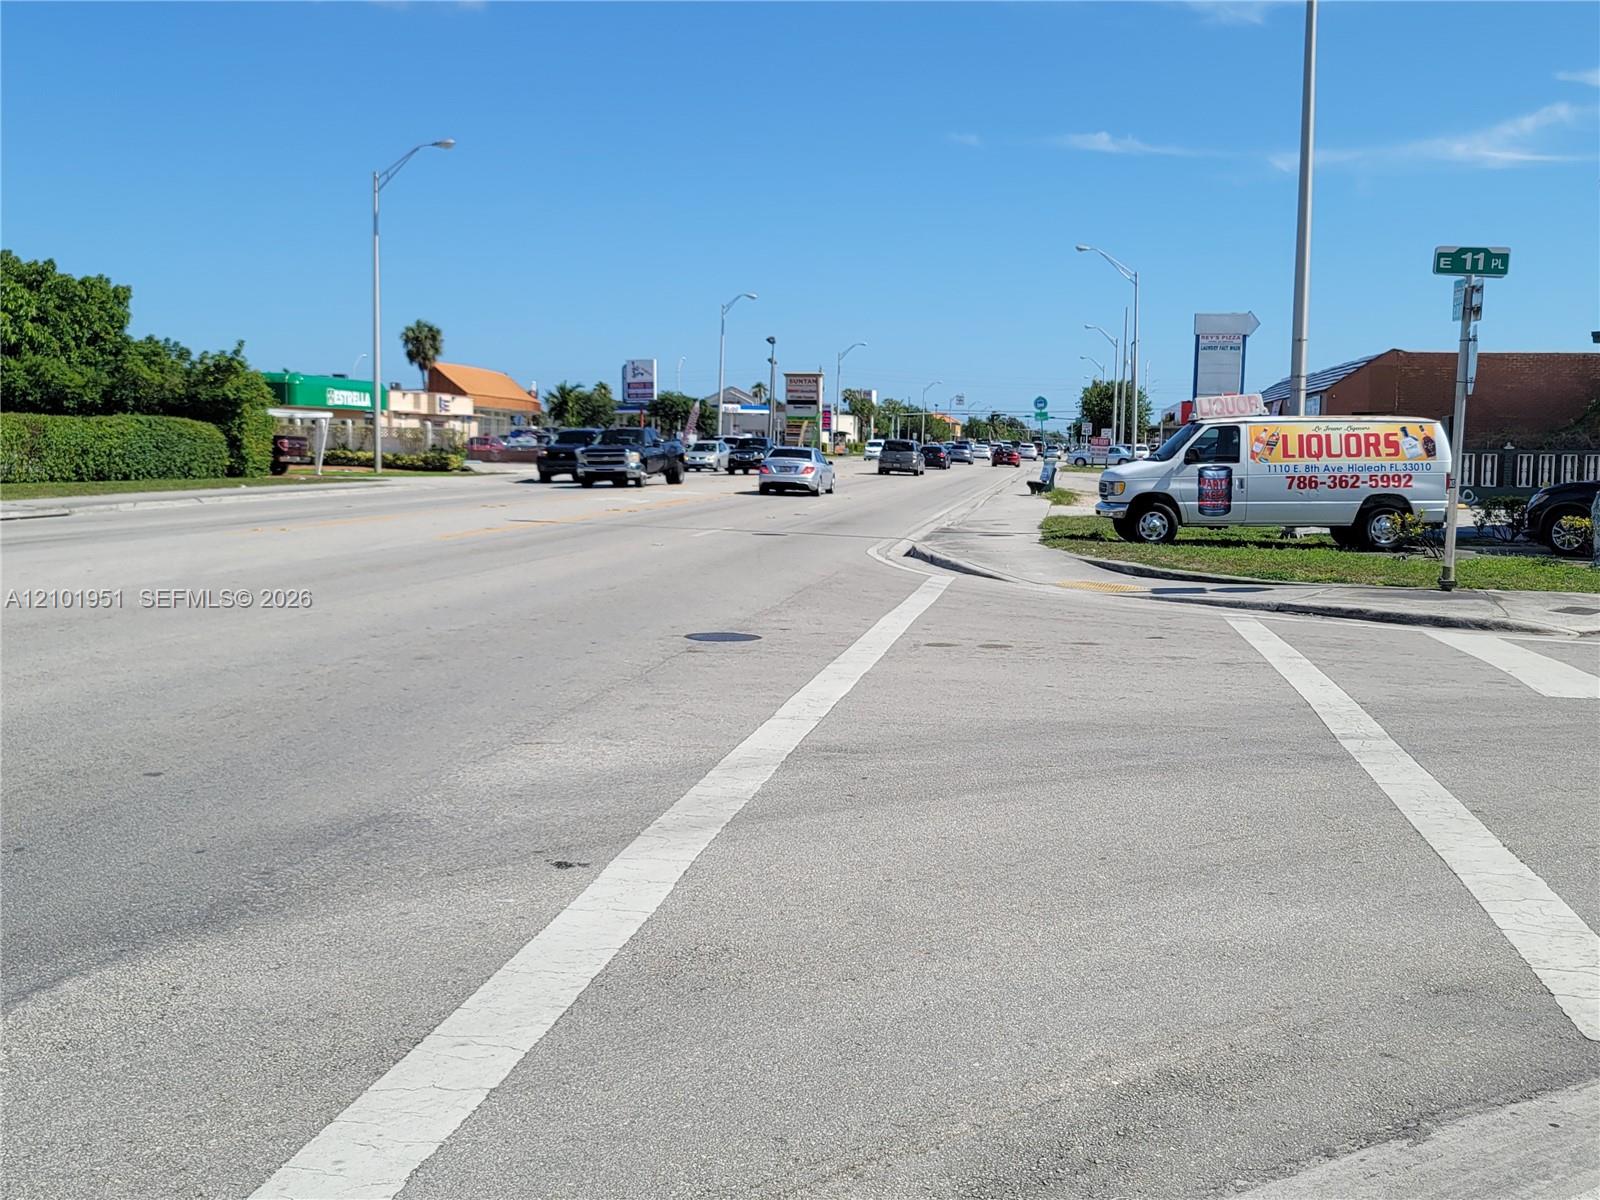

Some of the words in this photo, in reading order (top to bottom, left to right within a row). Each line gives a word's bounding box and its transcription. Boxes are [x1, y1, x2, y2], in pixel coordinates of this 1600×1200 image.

[1440, 257, 1452, 268] E
[1461, 252, 1485, 270] 11
[1491, 258, 1504, 269] PL
[335, 391, 371, 407] ESTRELLA
[1281, 432, 1401, 461] LIQUORS
[1267, 464, 1290, 473] 1110
[1293, 464, 1302, 472] E.
[1304, 464, 1320, 472] 8th
[1322, 464, 1343, 472] Ave
[1347, 463, 1387, 472] Hialeah
[1389, 462, 1432, 472] FL.33010
[1286, 474, 1413, 490] 786-362-5992
